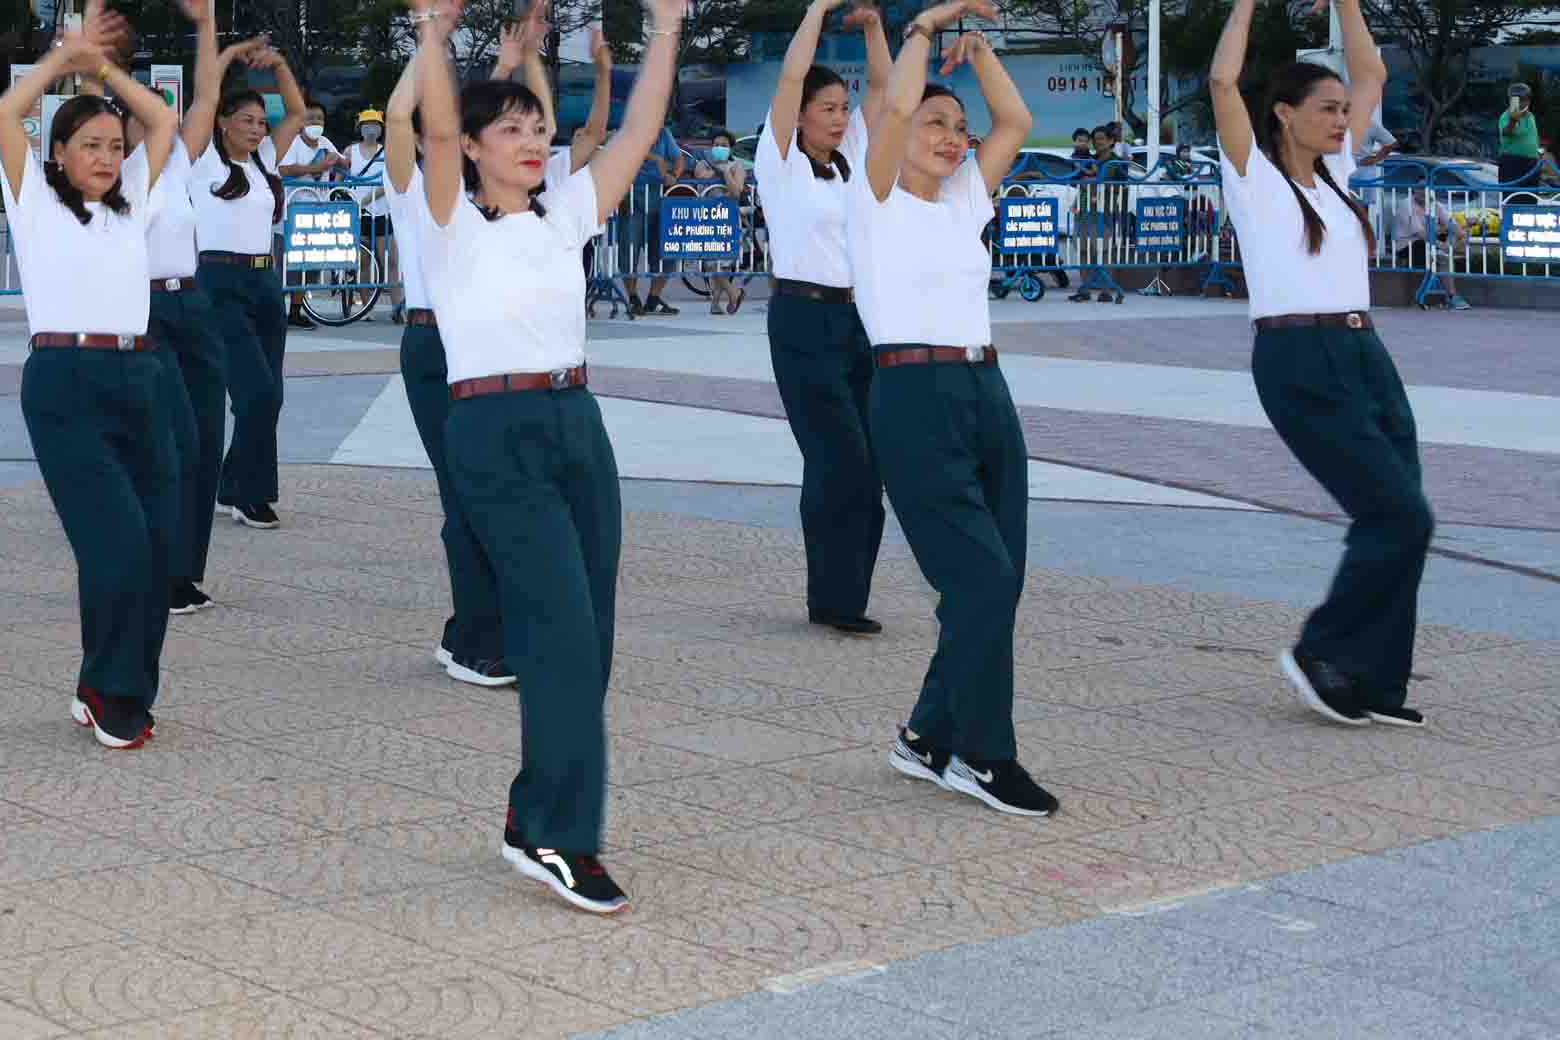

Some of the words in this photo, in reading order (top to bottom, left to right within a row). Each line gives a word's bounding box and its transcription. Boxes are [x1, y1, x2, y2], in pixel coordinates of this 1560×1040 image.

[1047, 76, 1089, 92] 0914
[671, 207, 689, 220] KHU
[692, 205, 709, 222] VỰC
[711, 202, 729, 220] CẤM
[685, 224, 715, 236] PHƯƠNG
[716, 223, 733, 238] TIỆN
